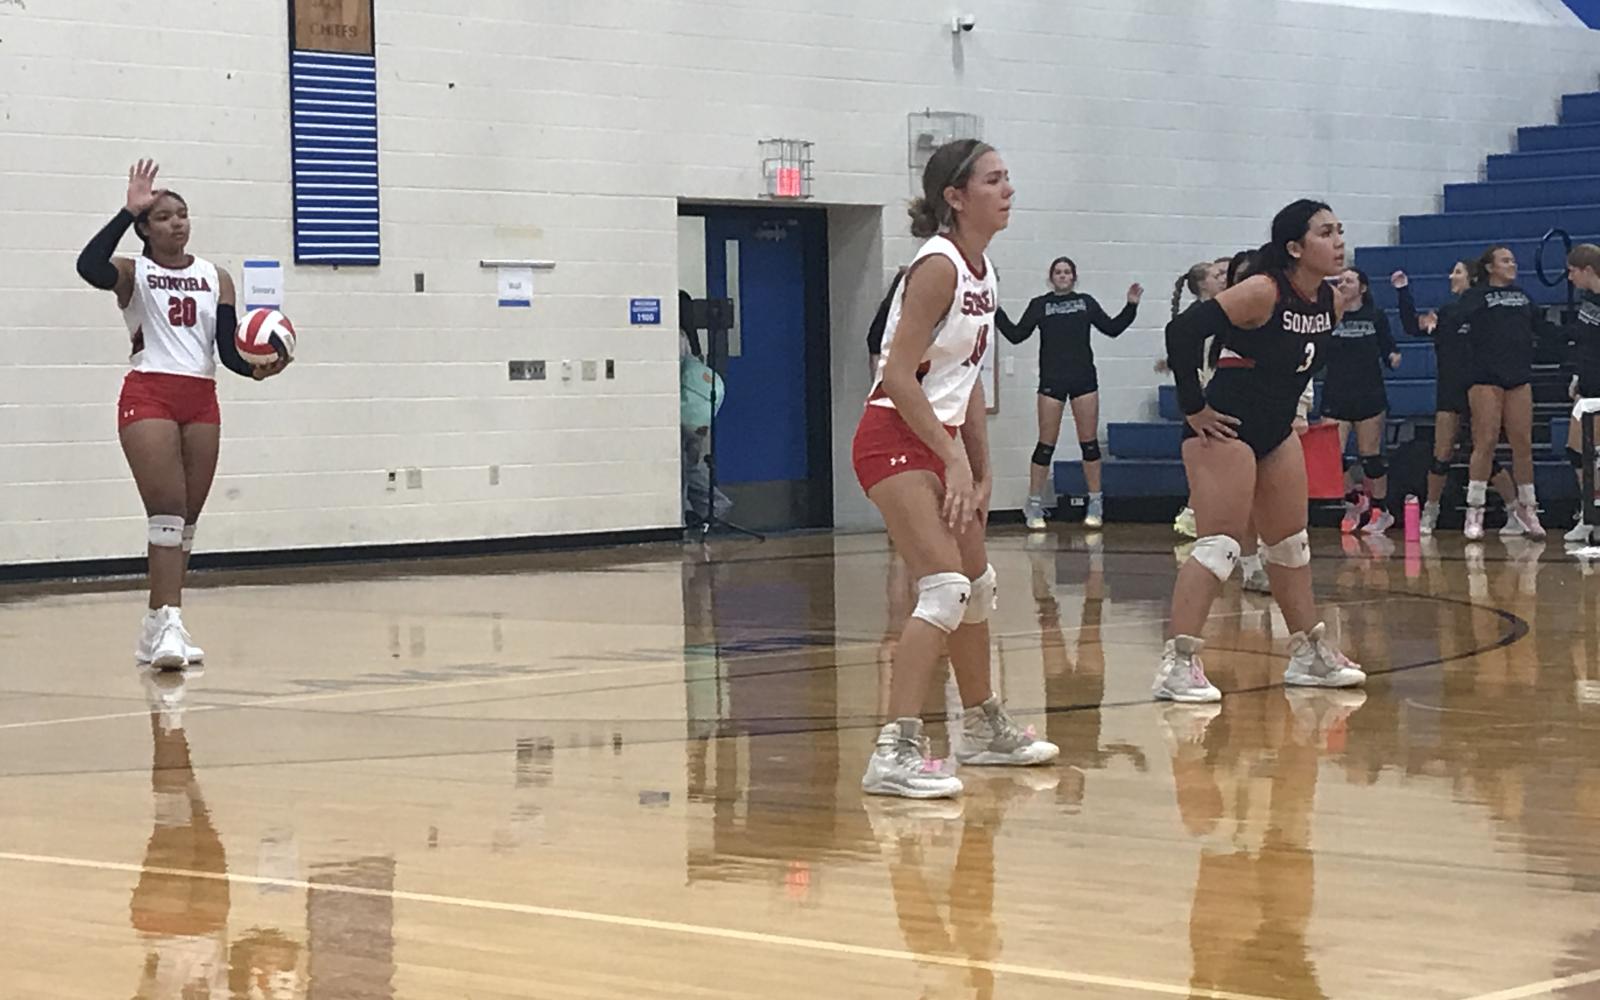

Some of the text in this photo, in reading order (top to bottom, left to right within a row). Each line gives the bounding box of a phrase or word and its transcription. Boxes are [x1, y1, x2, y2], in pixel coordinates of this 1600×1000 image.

[147, 275, 212, 293] SONORA
[168, 296, 197, 328] 20
[1296, 342, 1316, 374] 3
